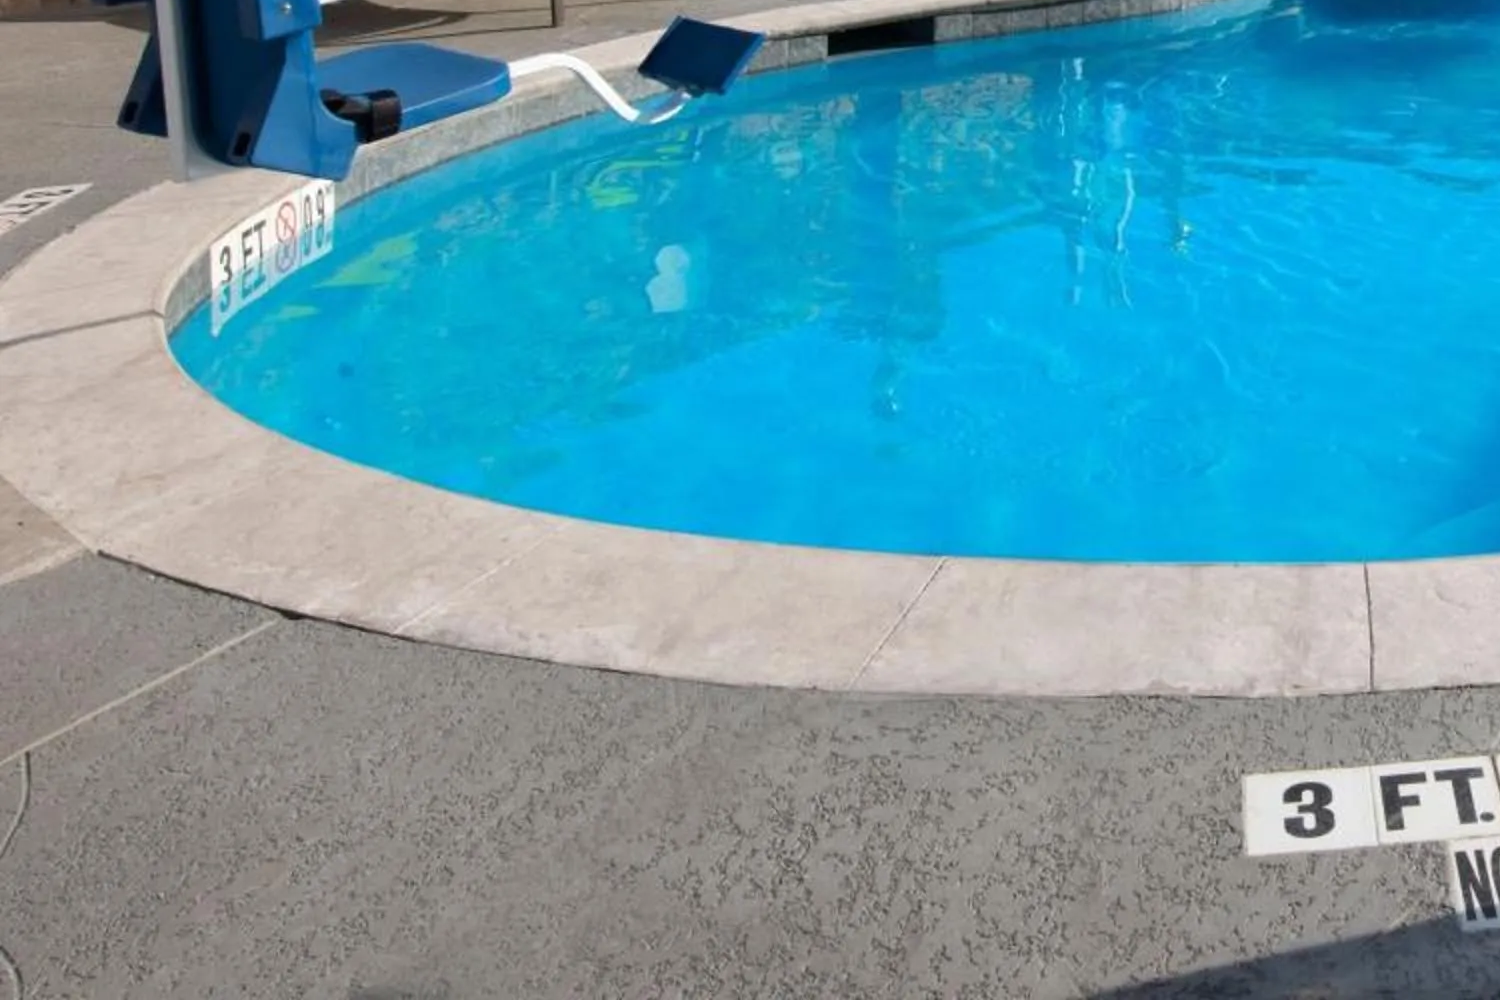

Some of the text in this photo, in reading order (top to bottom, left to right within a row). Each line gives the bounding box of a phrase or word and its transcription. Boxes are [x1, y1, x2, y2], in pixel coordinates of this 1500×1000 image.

[219, 245, 233, 285] 3
[241, 219, 267, 270] FT
[1282, 781, 1336, 839] 3
[1379, 766, 1496, 832] FT.
